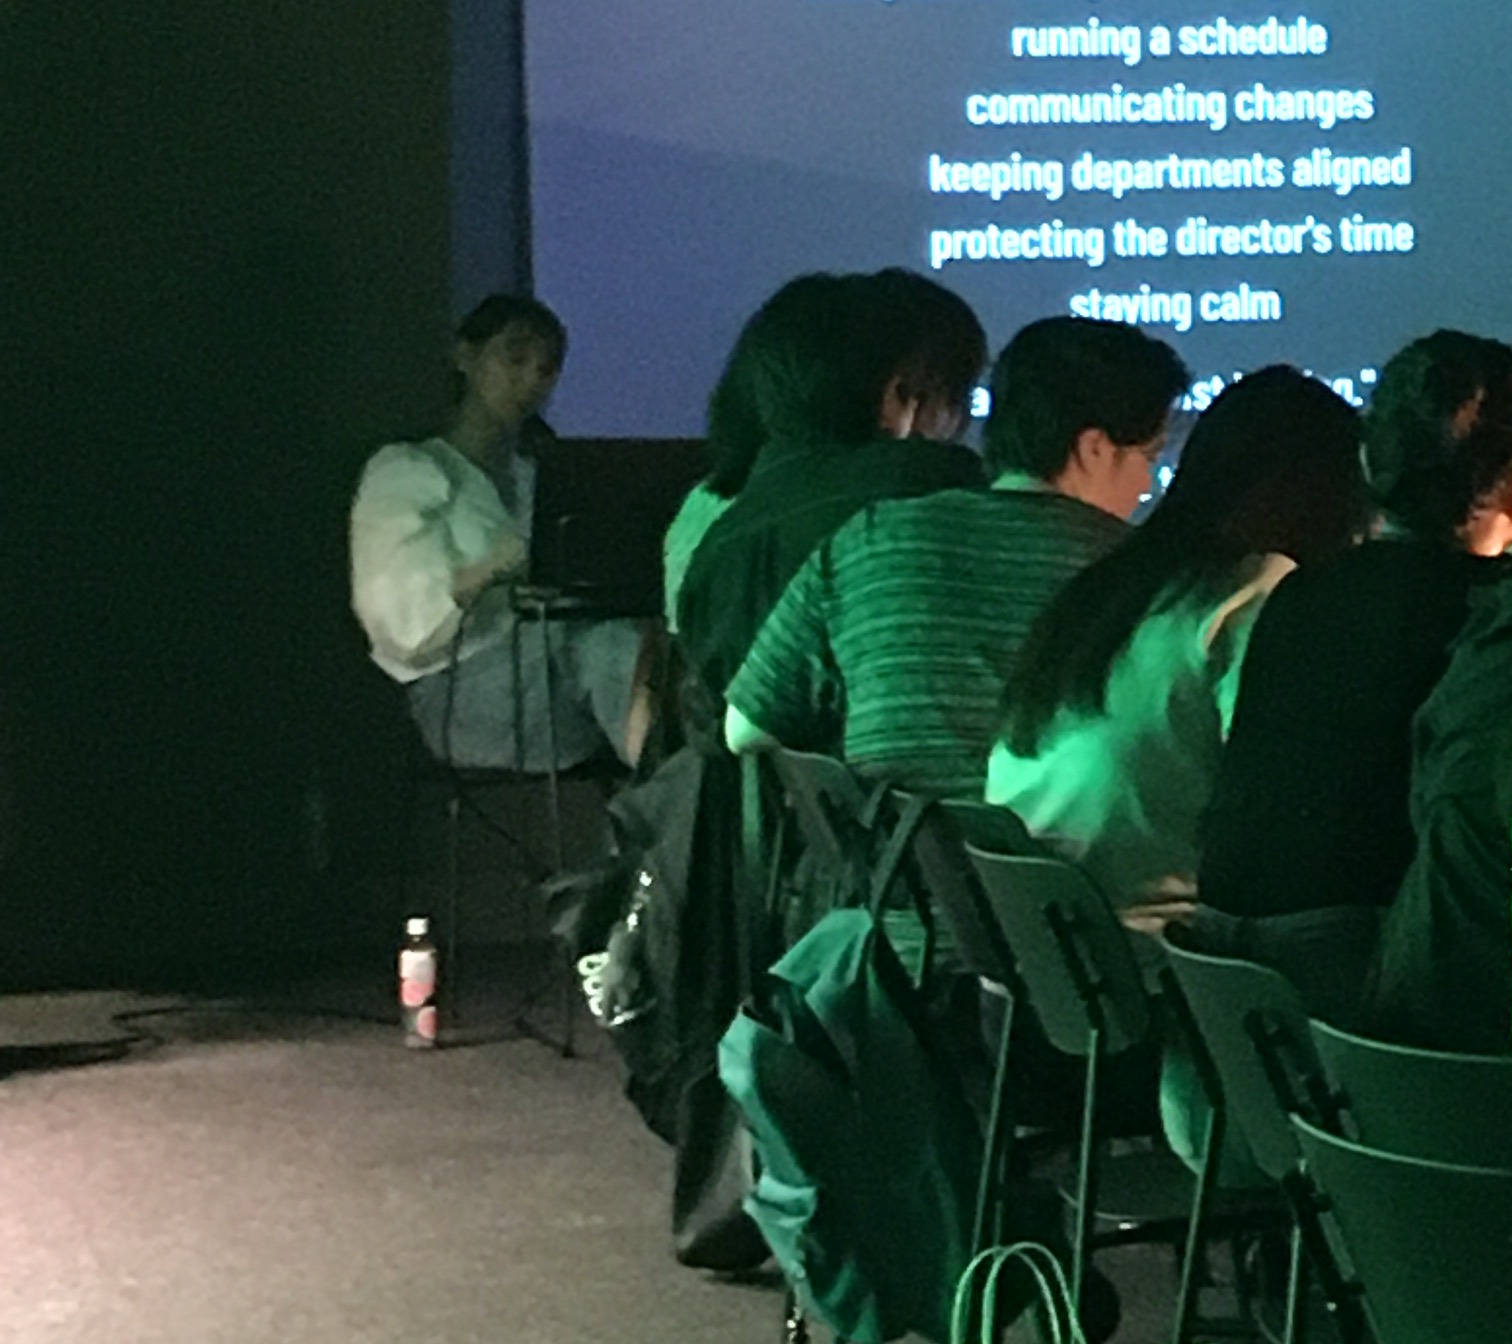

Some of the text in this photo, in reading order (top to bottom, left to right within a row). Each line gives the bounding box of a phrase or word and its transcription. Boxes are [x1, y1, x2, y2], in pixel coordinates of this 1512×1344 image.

[1012, 16, 1328, 66] running a schedule
[966, 82, 1374, 131] communicating changes
[929, 146, 1411, 201] keeping departments aligned
[931, 213, 1414, 269] protecting the director's time
[1070, 282, 1281, 332] staying calm
